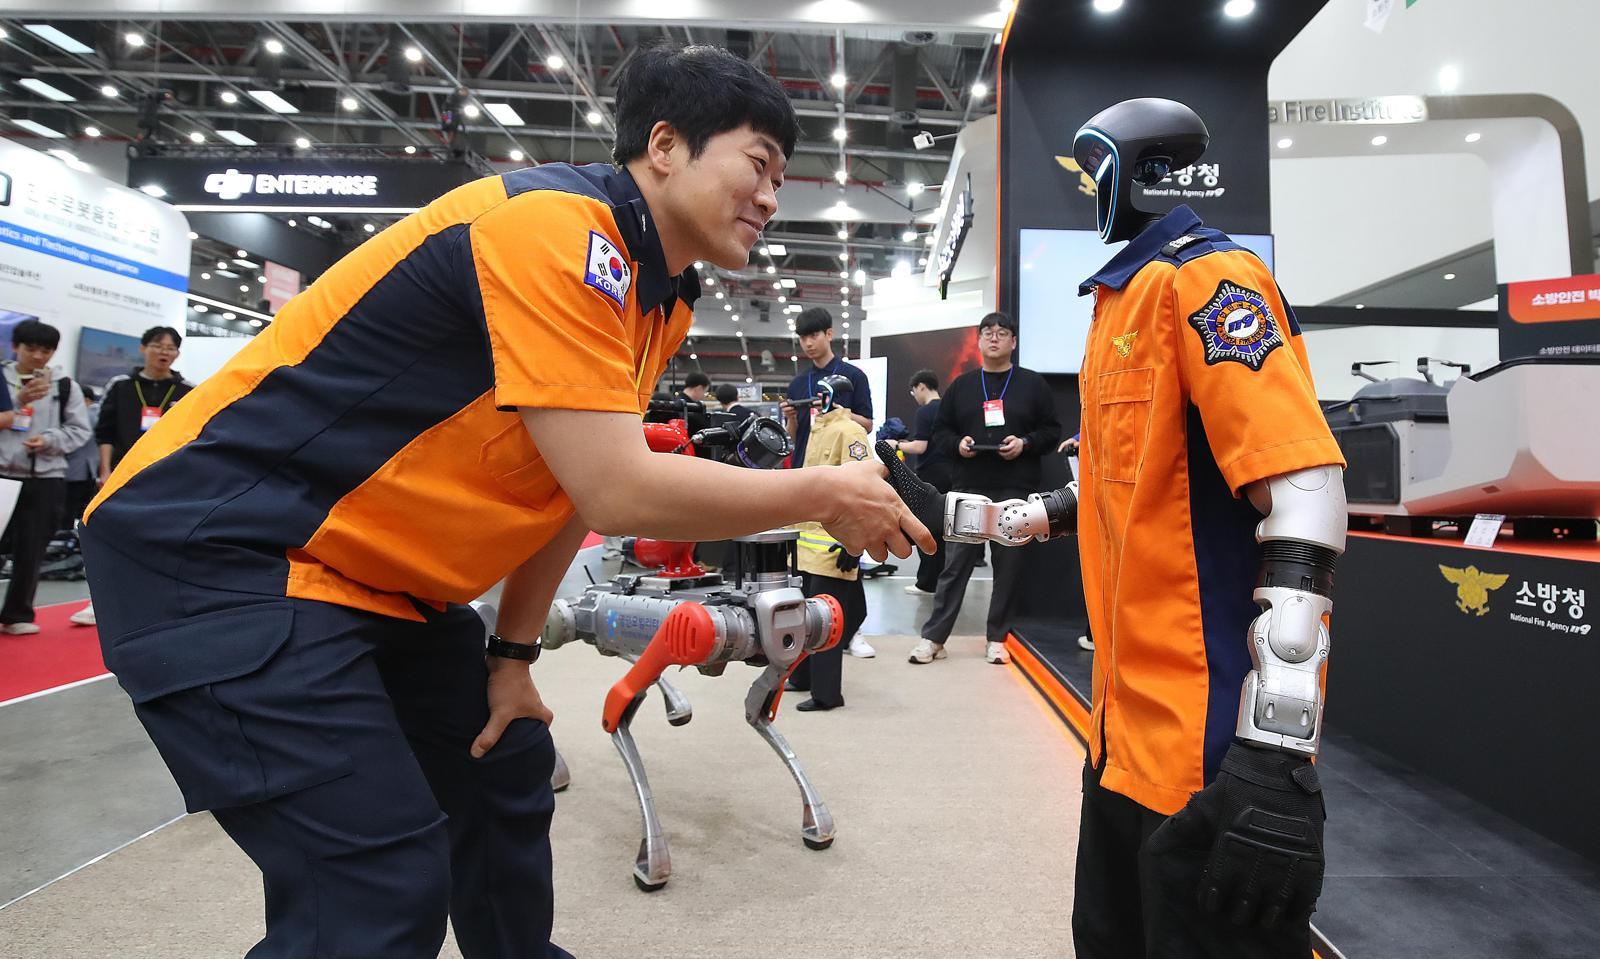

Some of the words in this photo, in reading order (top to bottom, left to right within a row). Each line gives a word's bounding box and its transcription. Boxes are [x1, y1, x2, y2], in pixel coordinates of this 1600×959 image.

[1283, 101, 1326, 122] Fire
[255, 174, 377, 195] ENTERPRISE
[1162, 164, 1219, 187] 방청
[1143, 188, 1169, 196] National
[1182, 189, 1205, 198] Agency
[22, 234, 41, 246] and
[41, 236, 90, 262] Technology
[1531, 289, 1585, 306] 소방안전
[1539, 345, 1571, 355] 소방안전
[1515, 581, 1585, 620] 소방청
[1510, 612, 1534, 624] National
[1534, 617, 1545, 627] Fire
[1546, 620, 1570, 633] Agency
